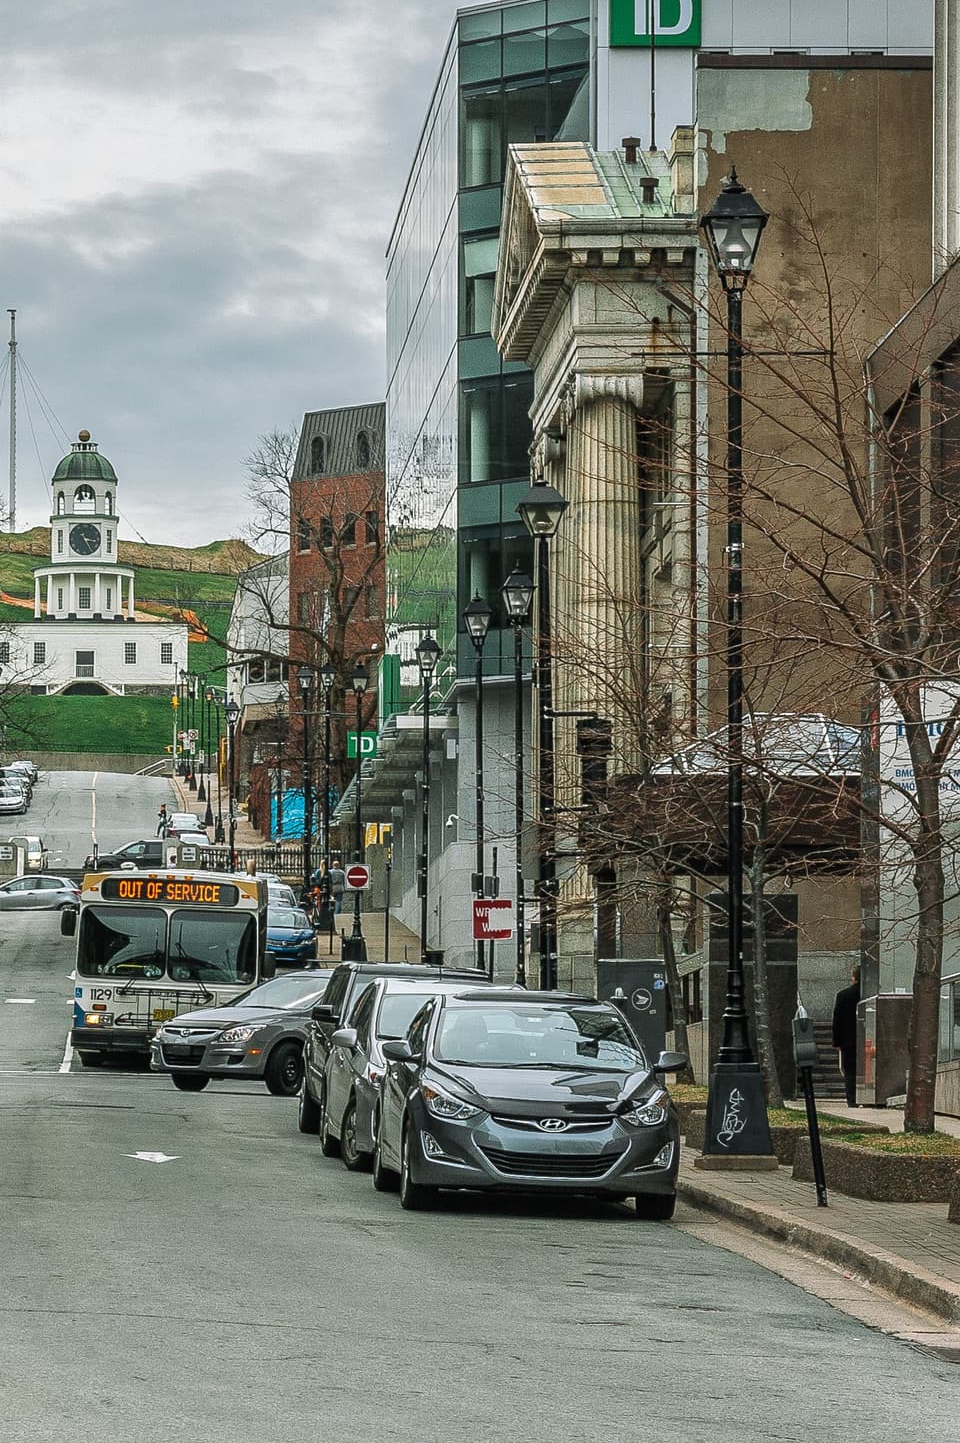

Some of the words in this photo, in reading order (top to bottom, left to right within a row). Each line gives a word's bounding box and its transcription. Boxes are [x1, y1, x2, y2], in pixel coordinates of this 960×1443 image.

[350, 736, 374, 753] TD
[119, 880, 144, 898] OUT
[146, 882, 163, 899] OF
[166, 883, 220, 903] SERVICE
[90, 988, 112, 1001] 1129
